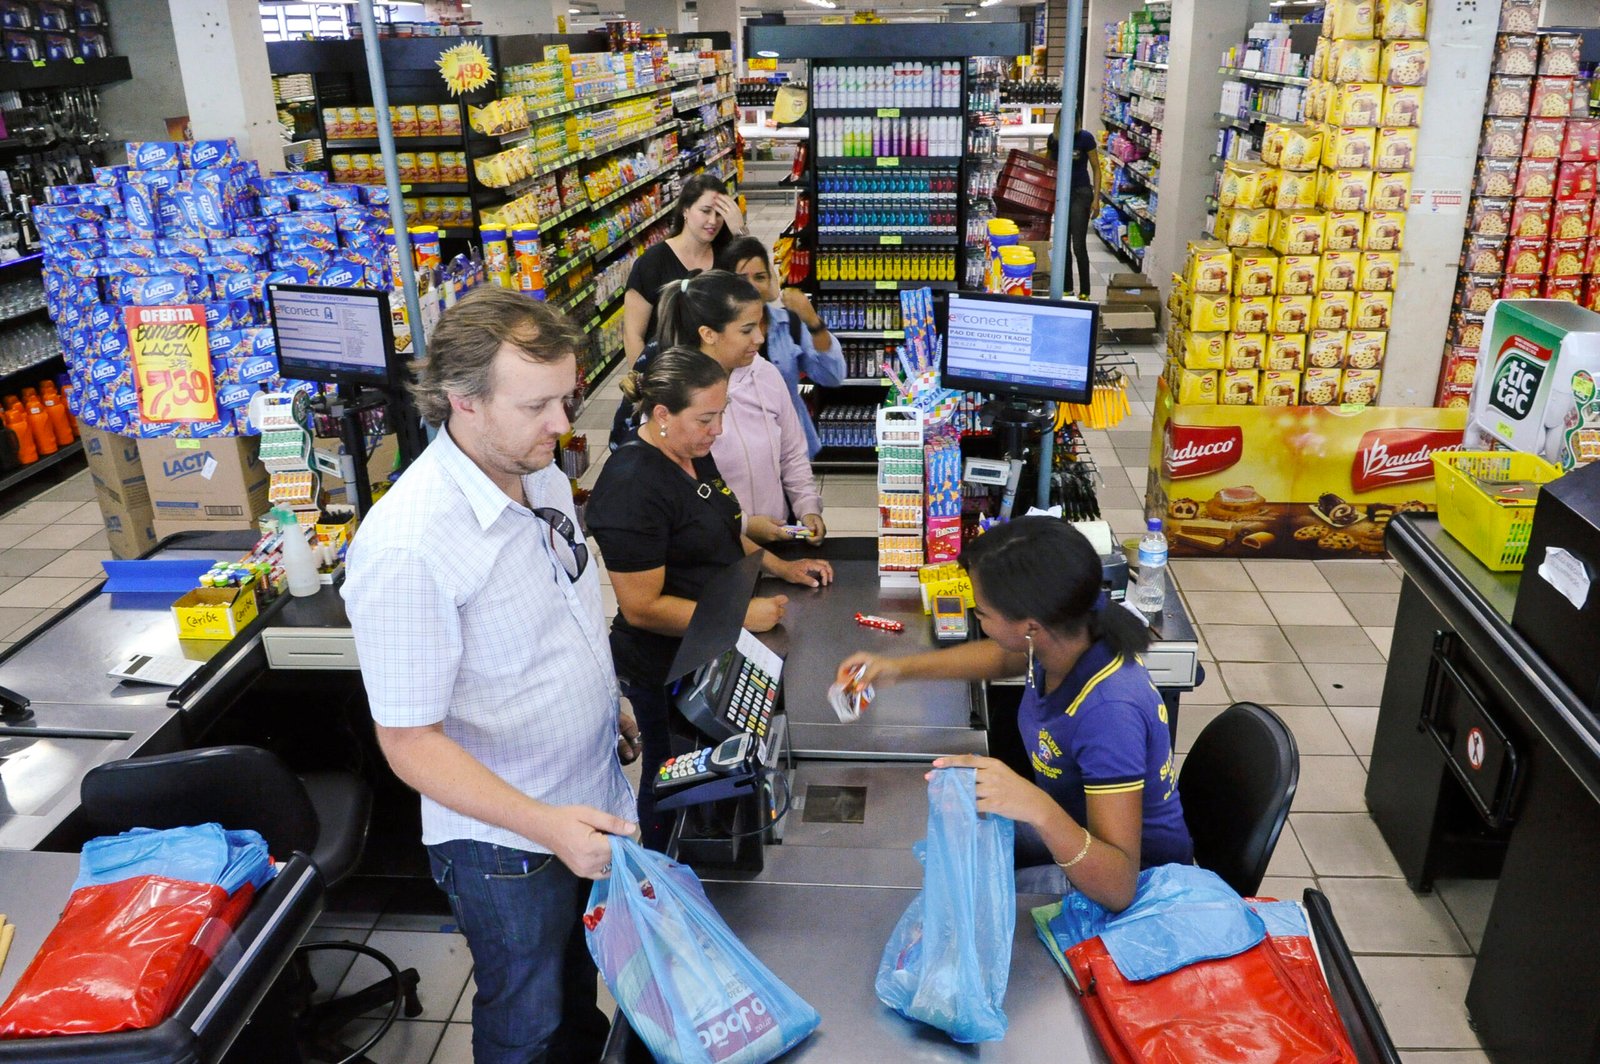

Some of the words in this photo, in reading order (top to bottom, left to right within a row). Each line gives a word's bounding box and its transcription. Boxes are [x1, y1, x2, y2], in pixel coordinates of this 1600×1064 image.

[139, 148, 167, 164] LACTA
[192, 146, 218, 163] LACTA
[228, 278, 251, 292] LACT
[322, 271, 353, 287] LACTA
[144, 282, 175, 299] LACTA
[140, 308, 194, 322] OFERTA
[141, 343, 192, 357] LACTA
[243, 361, 274, 378] LACTA
[1507, 360, 1536, 395] tic
[219, 389, 250, 406] LACTA
[1496, 377, 1529, 415] tac
